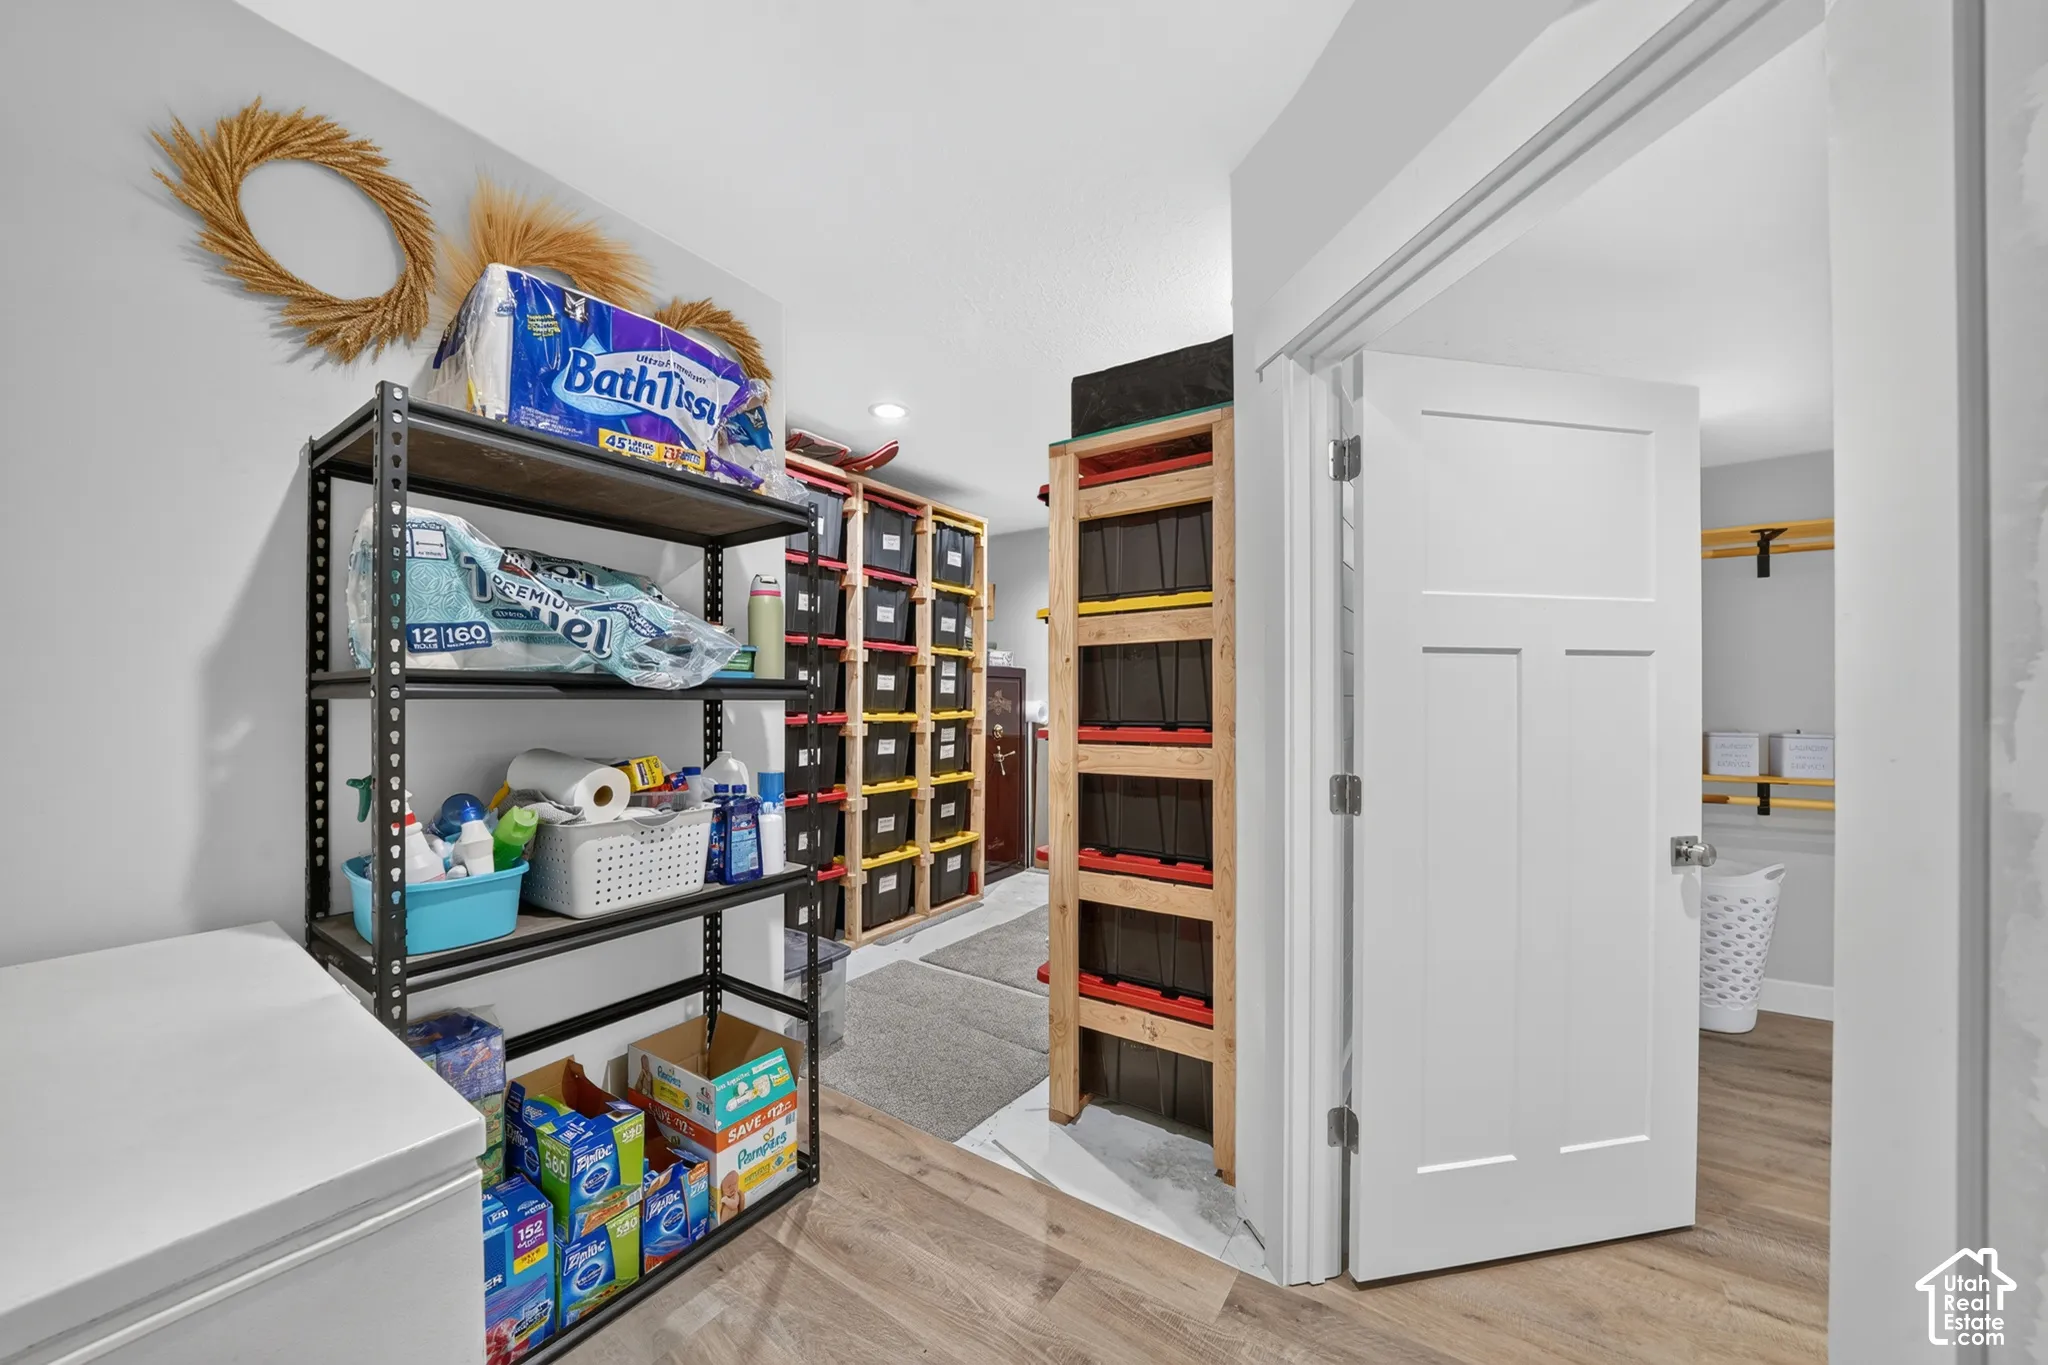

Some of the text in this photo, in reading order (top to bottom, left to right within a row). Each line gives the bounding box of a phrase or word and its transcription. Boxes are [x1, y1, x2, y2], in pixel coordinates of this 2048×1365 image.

[605, 434, 628, 449] 45
[412, 628, 438, 643] 12
[446, 625, 486, 643] 160
[727, 1114, 761, 1143] SAVE
[517, 1219, 543, 1241] 152
